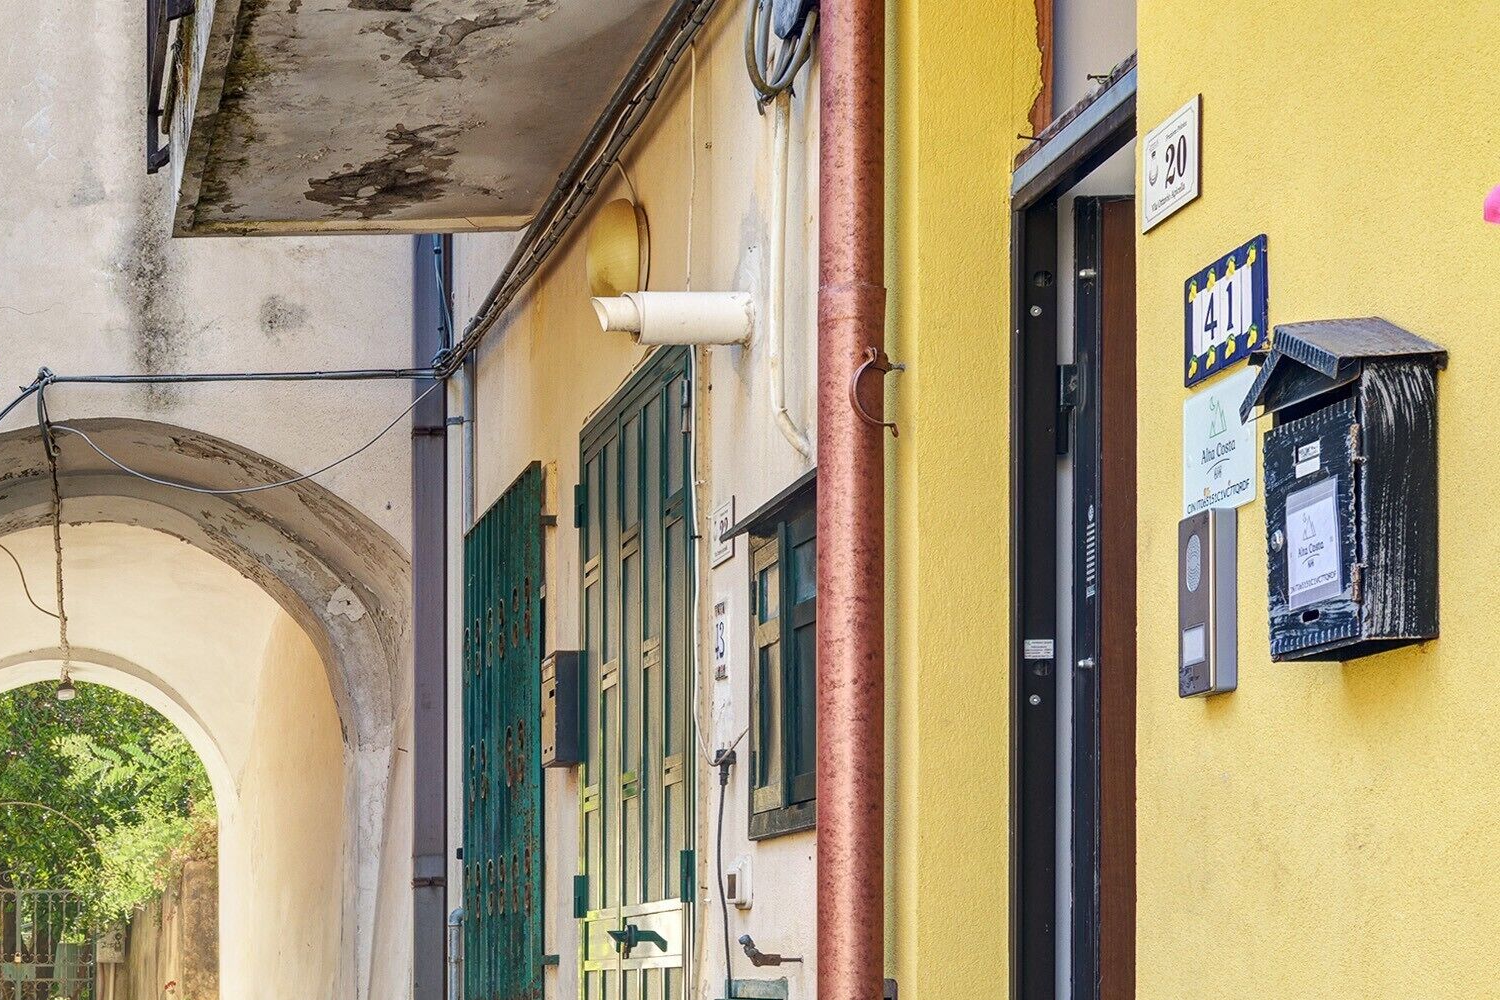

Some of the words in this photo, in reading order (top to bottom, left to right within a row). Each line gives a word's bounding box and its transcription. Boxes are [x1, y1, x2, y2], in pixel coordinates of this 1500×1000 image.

[1165, 135, 1187, 189] 20
[1204, 281, 1234, 340] 41
[1216, 440, 1235, 457] Costa
